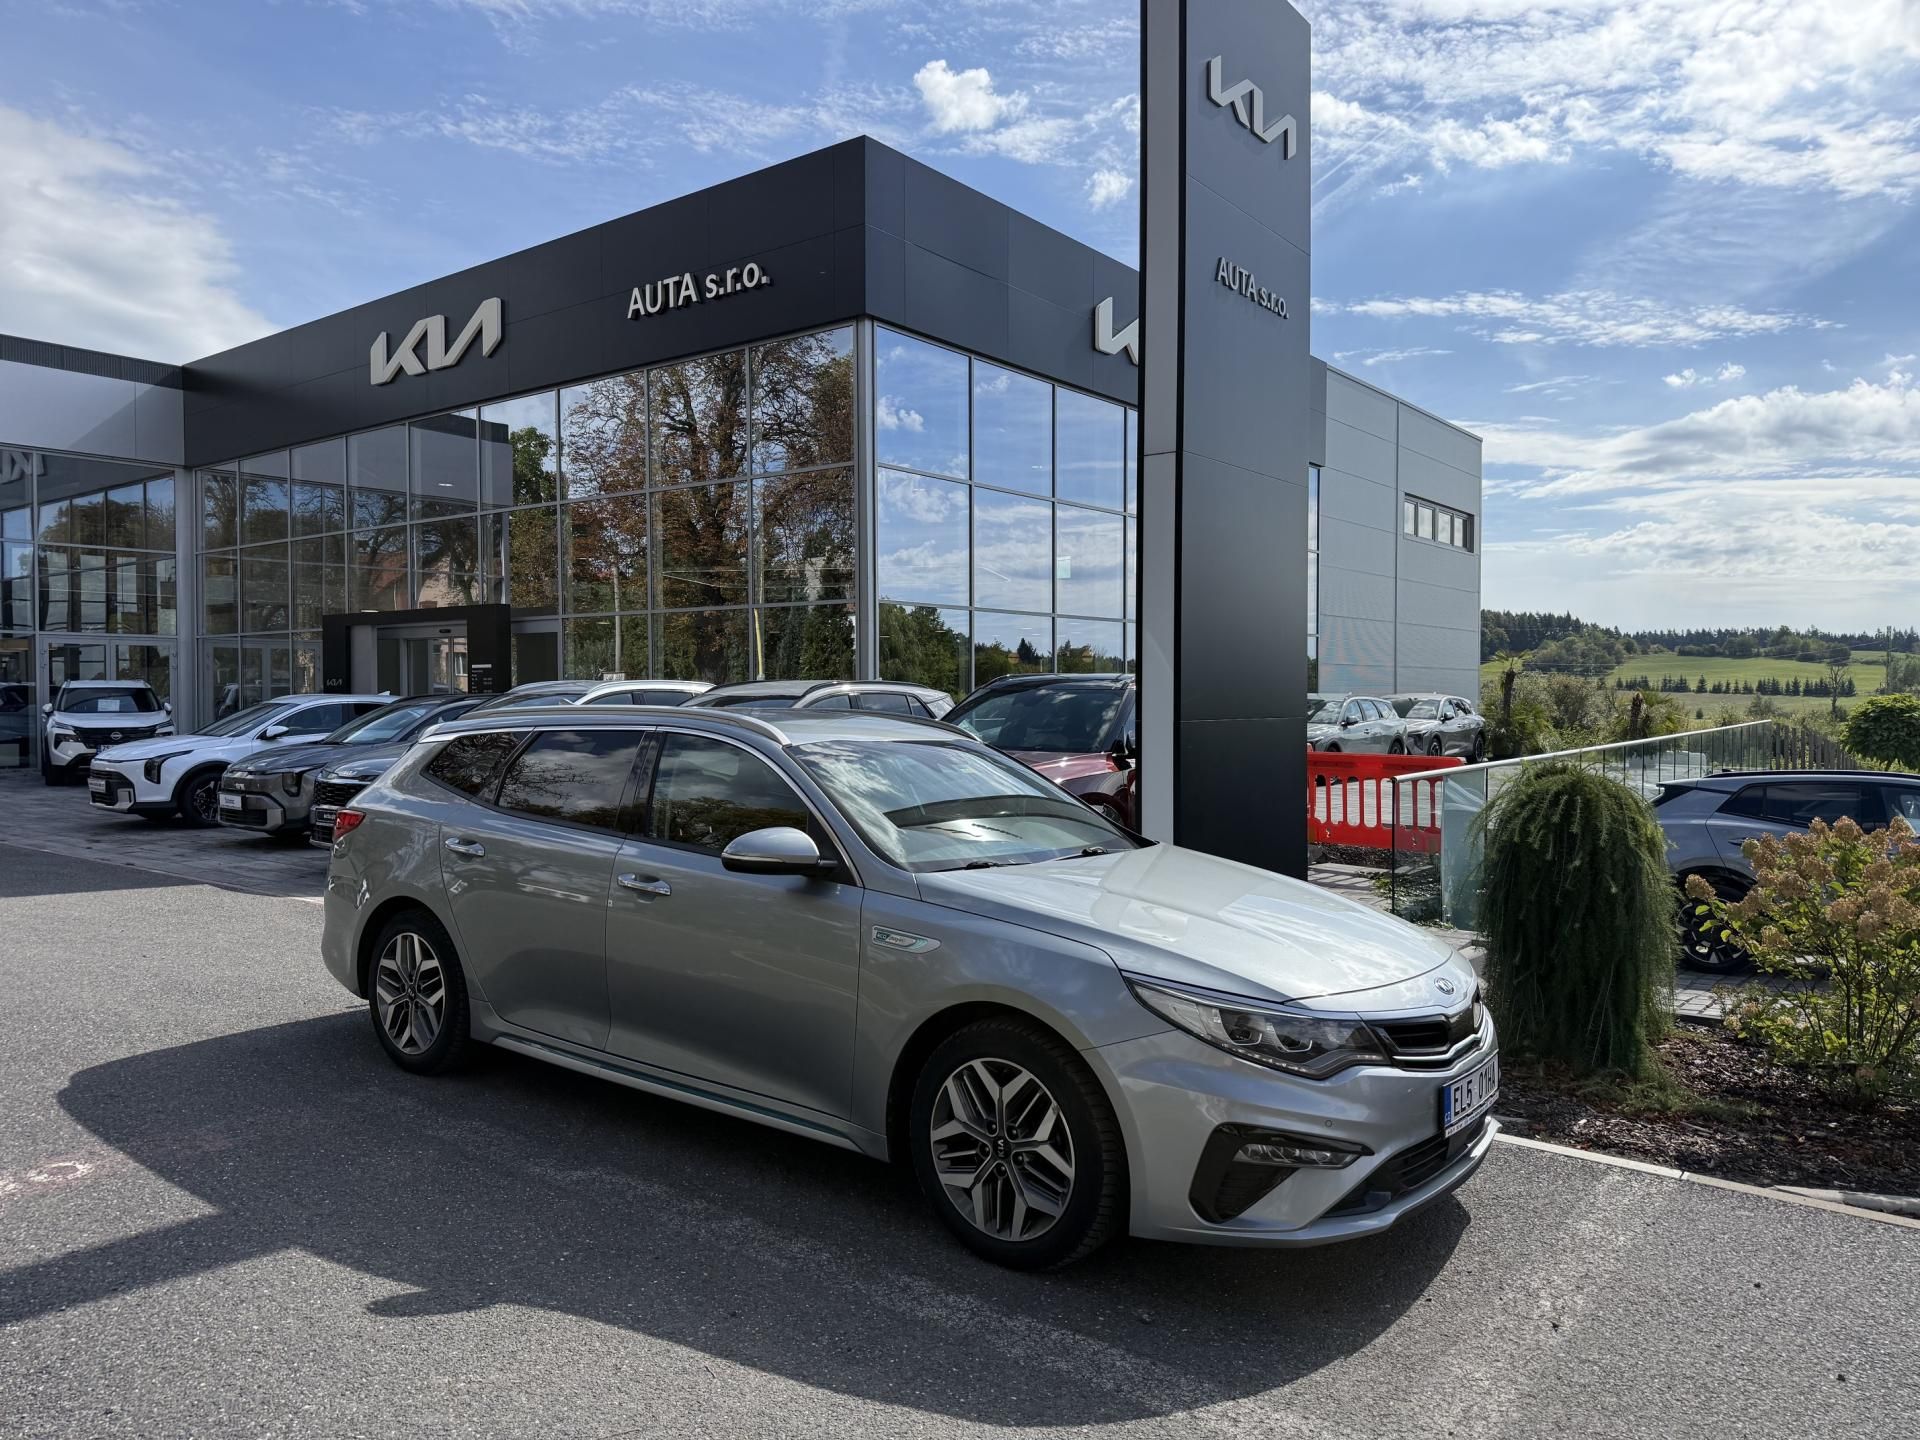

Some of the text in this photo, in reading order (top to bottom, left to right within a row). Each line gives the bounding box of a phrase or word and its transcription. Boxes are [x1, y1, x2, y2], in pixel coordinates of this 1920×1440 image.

[1207, 55, 1297, 160] KIA
[627, 262, 770, 319] AUTA s.r.o.
[1216, 257, 1289, 319] AUTA s.r.o.
[370, 297, 502, 385] KIA
[1453, 1079, 1473, 1116] EL5
[1479, 1061, 1496, 1100] 01HA
